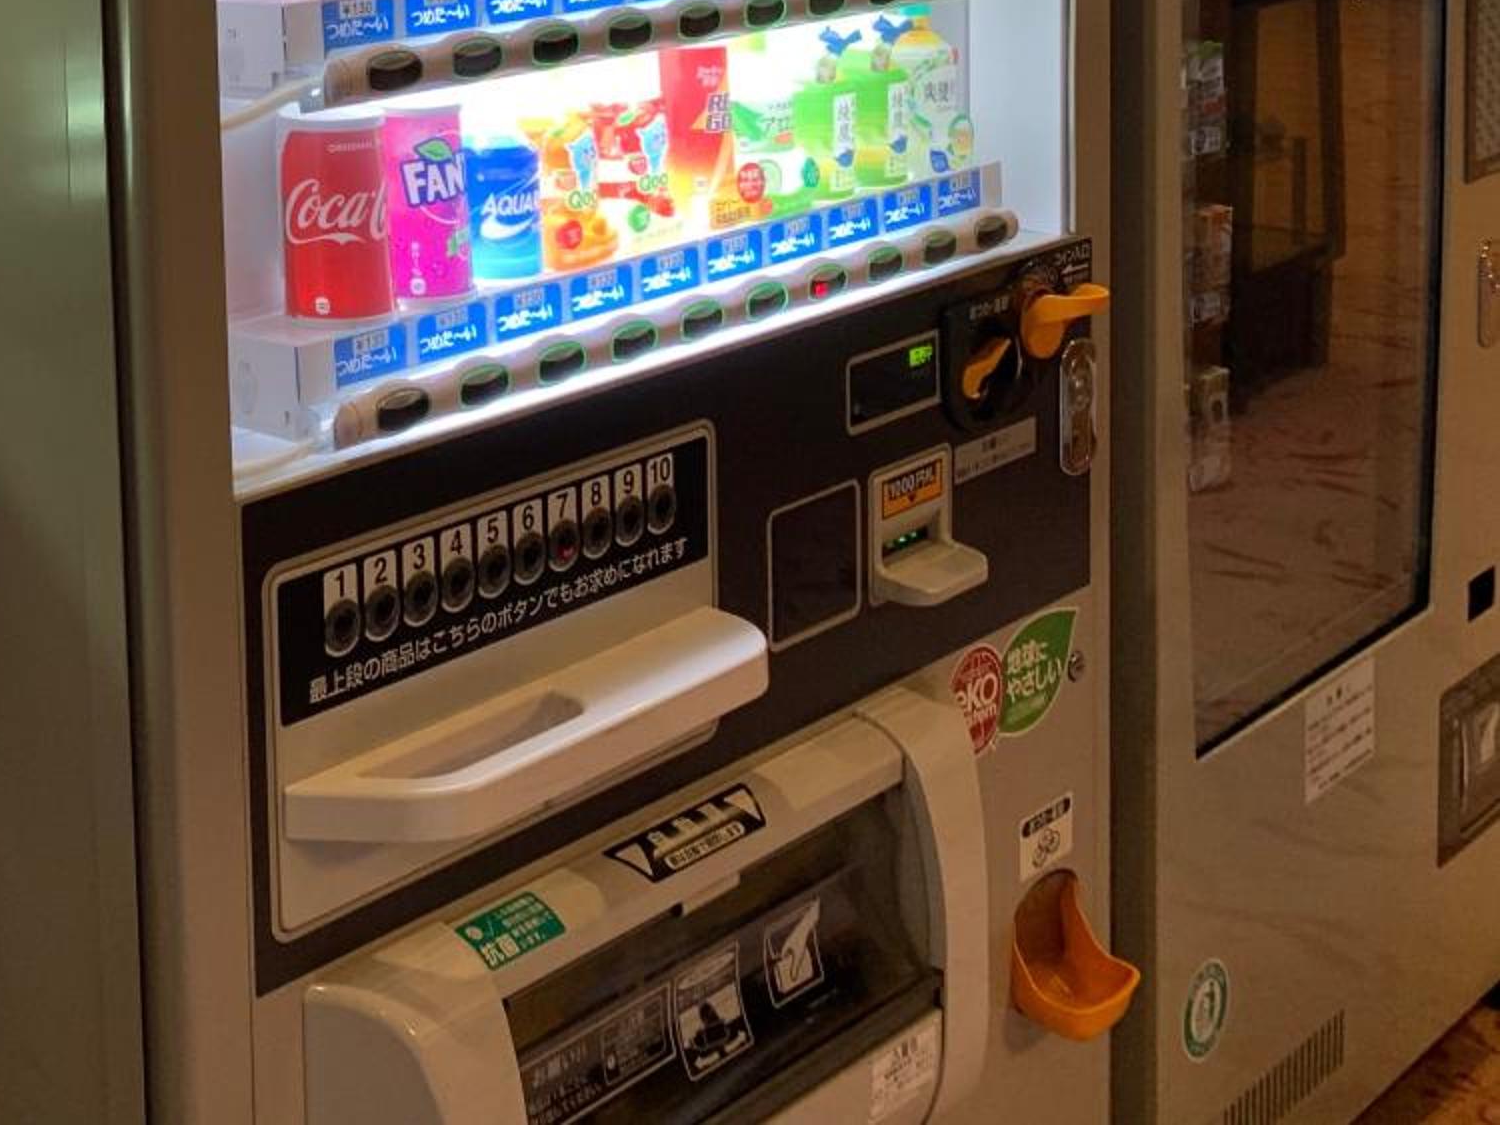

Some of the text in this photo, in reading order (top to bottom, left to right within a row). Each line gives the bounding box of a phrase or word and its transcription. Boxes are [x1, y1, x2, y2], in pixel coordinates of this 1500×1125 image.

[623, 470, 635, 494] 9
[650, 456, 672, 484] 10
[556, 492, 570, 518] 7
[591, 481, 602, 505] 8
[522, 505, 534, 529] 6
[450, 530, 463, 555] 4
[486, 518, 499, 543] 5
[413, 543, 425, 570] 3
[374, 557, 387, 584] 2
[336, 574, 346, 598] 1
[309, 536, 689, 705] 最上段の商品はこちらのボタンでもお求めになれます
